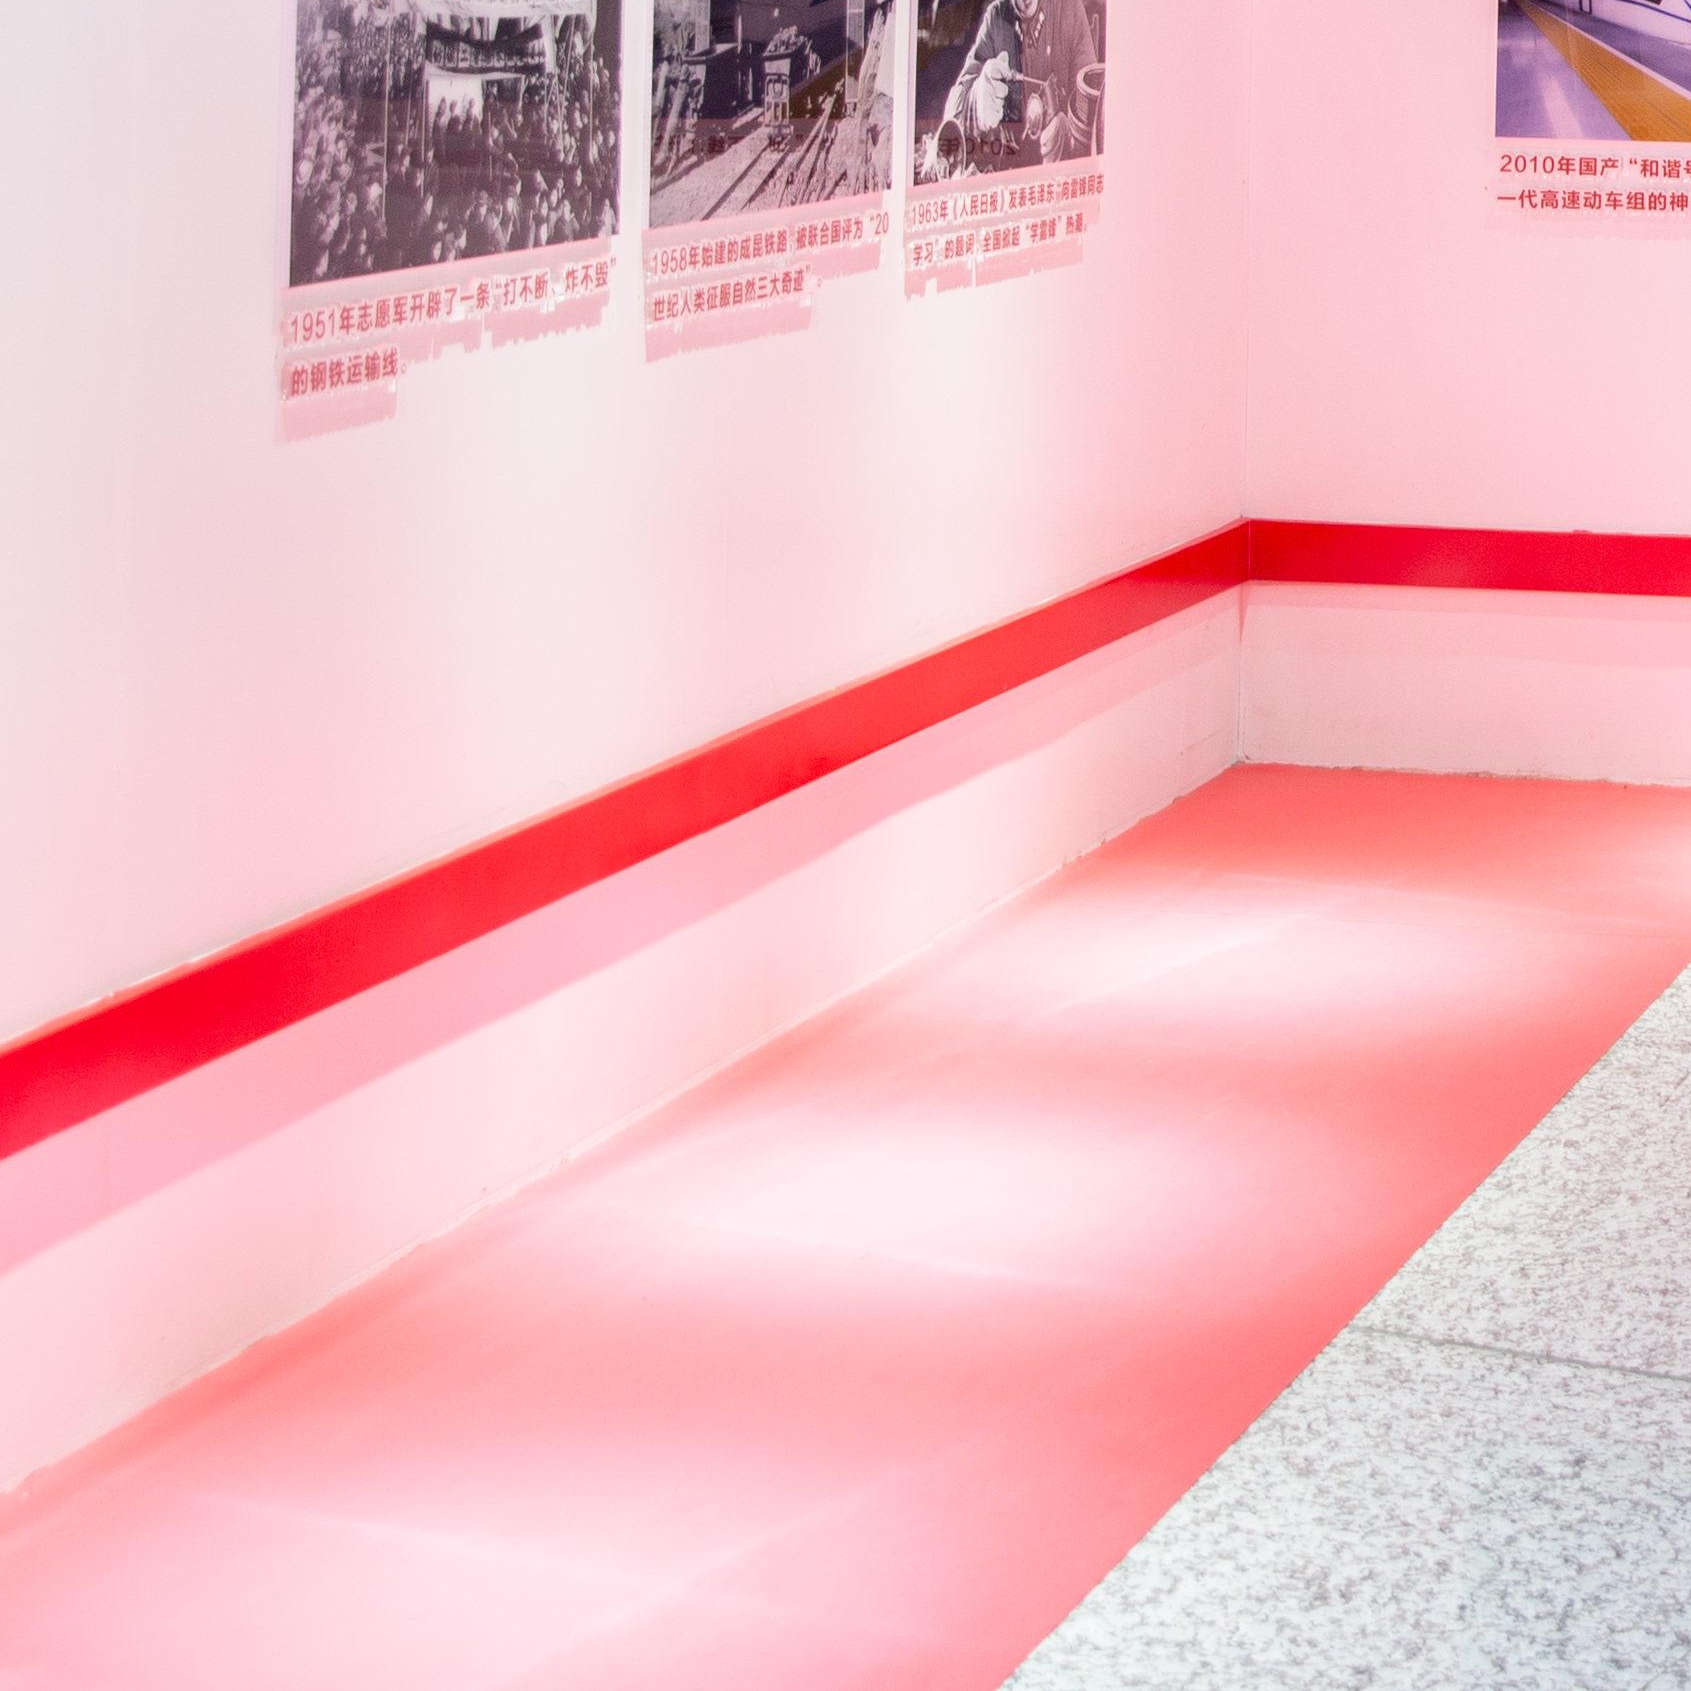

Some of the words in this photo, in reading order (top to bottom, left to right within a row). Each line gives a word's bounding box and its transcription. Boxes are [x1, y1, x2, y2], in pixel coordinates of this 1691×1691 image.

[652, 211, 890, 276] 1958年始建的成昆铁路，被联合国评为“20
[291, 255, 617, 344] 1951年志愿军开辟了一条“打不断、炸不毁”
[653, 264, 823, 323] 世纪人类征服自然三大奇迹”。
[291, 347, 408, 397] 的钢铁运输线。
